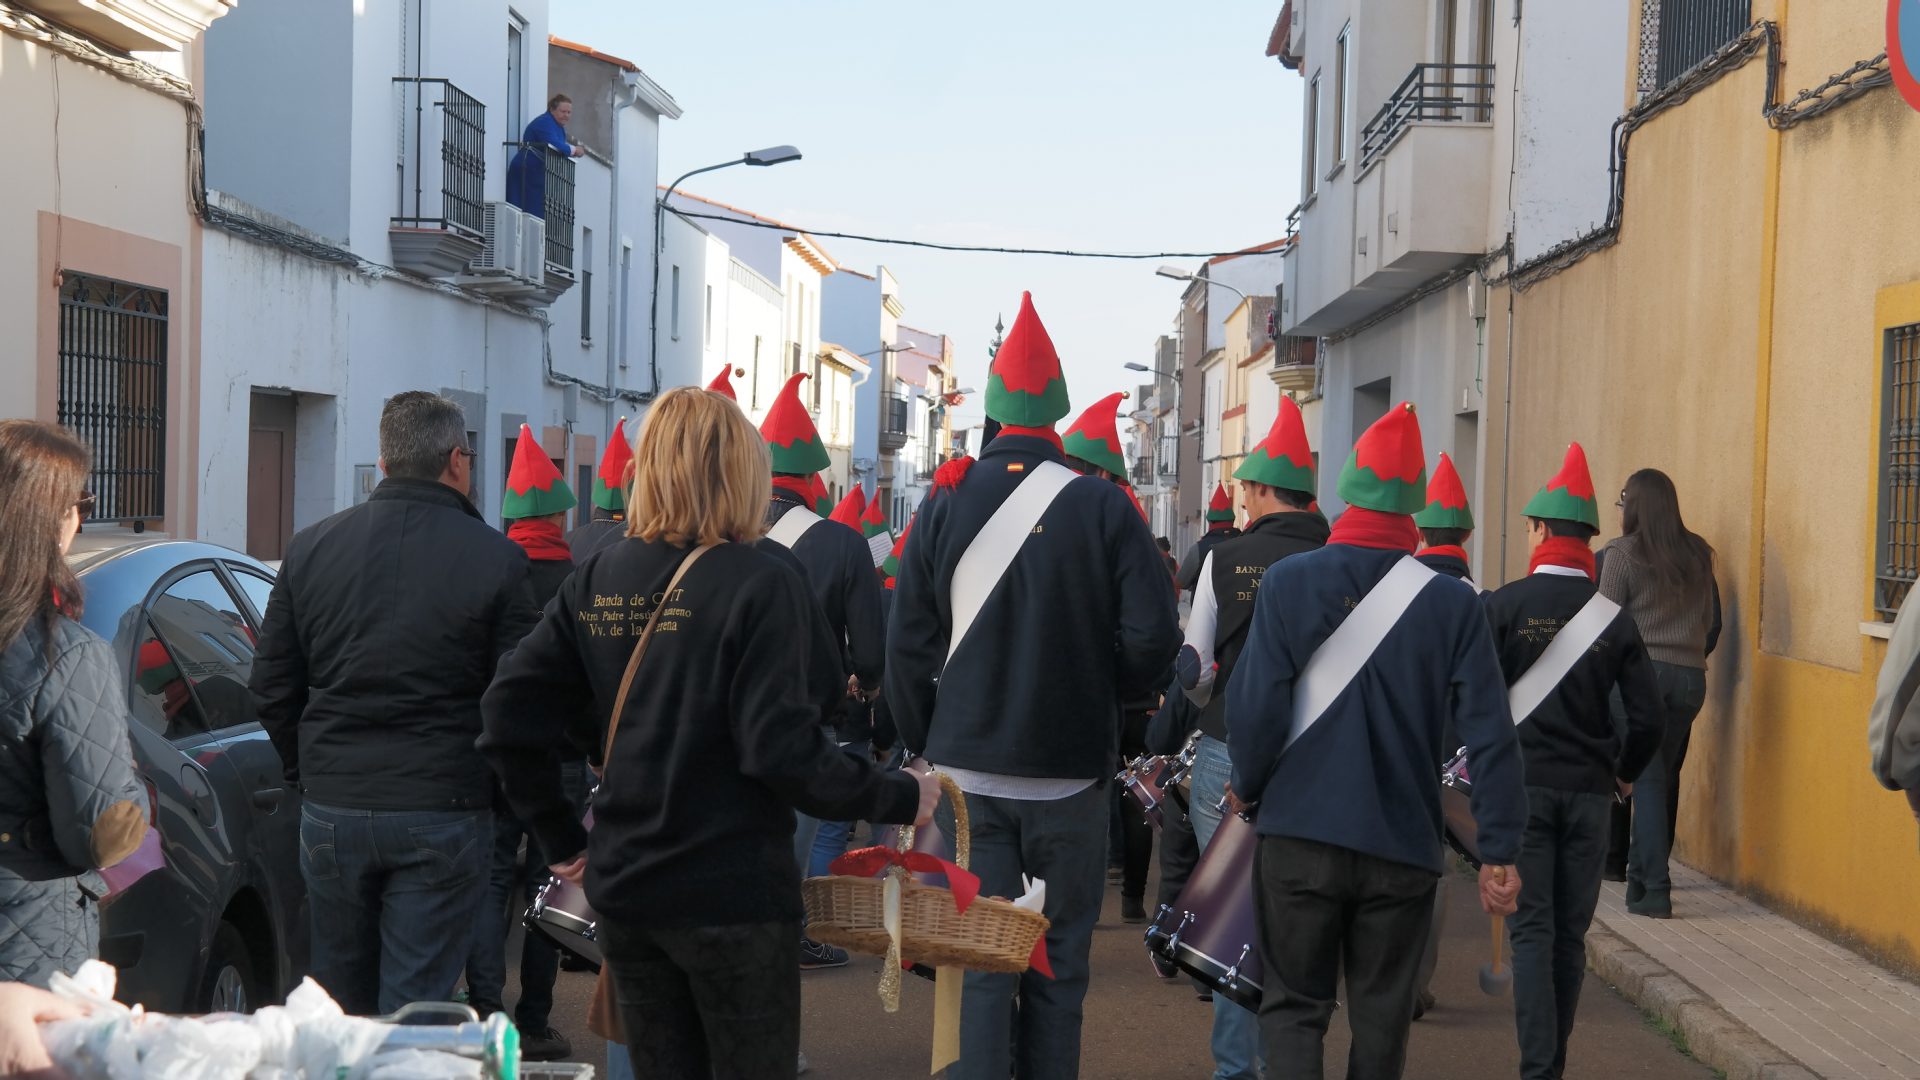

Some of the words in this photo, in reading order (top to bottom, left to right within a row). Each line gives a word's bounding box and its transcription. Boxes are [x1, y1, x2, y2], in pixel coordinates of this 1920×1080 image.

[1235, 565, 1266, 574] BAND
[593, 594, 623, 607] Banda
[630, 594, 645, 606] de
[602, 610, 624, 621] Padre
[1528, 617, 1556, 626] Banda
[610, 623, 623, 637] de
[631, 622, 643, 636] la
[655, 620, 677, 633] erena
